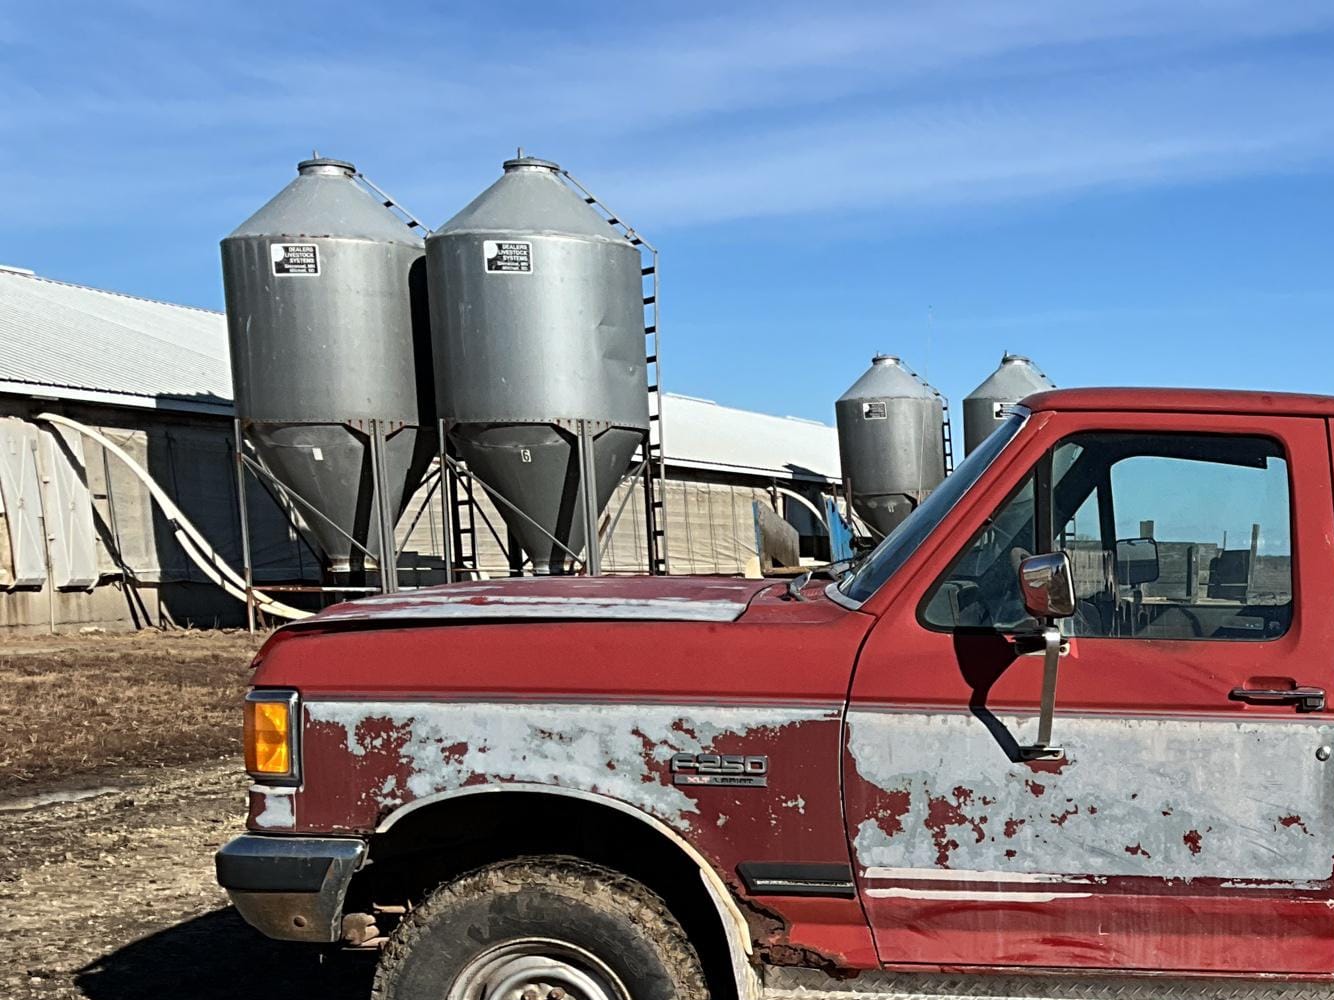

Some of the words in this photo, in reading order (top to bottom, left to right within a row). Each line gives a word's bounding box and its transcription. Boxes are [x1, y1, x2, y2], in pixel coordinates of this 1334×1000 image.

[522, 450, 530, 461] 6
[670, 752, 768, 774] F-250
[687, 776, 710, 784] XLT
